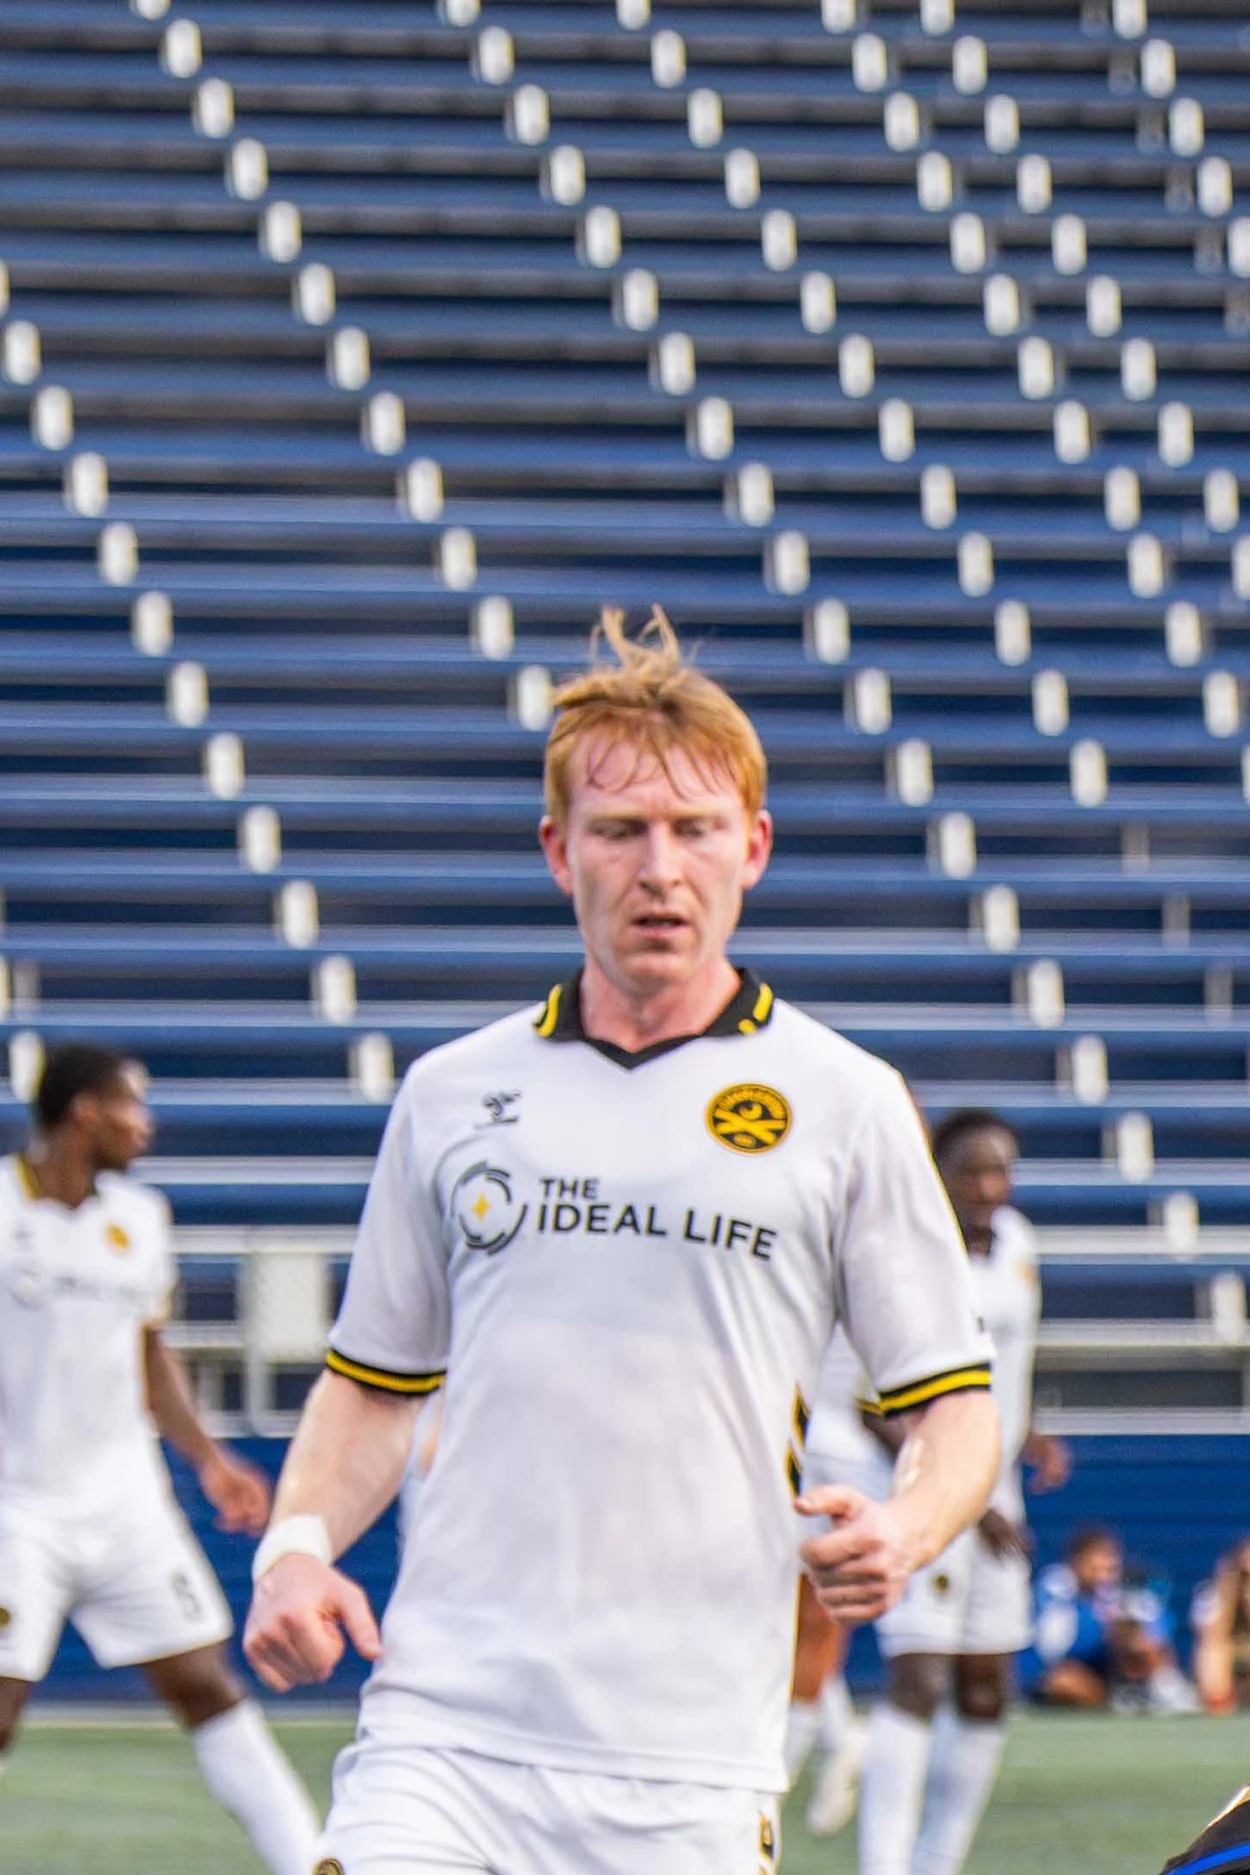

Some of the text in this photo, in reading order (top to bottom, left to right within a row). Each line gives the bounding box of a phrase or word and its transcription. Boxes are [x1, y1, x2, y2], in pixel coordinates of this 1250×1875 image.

[540, 1178, 600, 1201] THE
[537, 1204, 778, 1262] IDEAL LIFE
